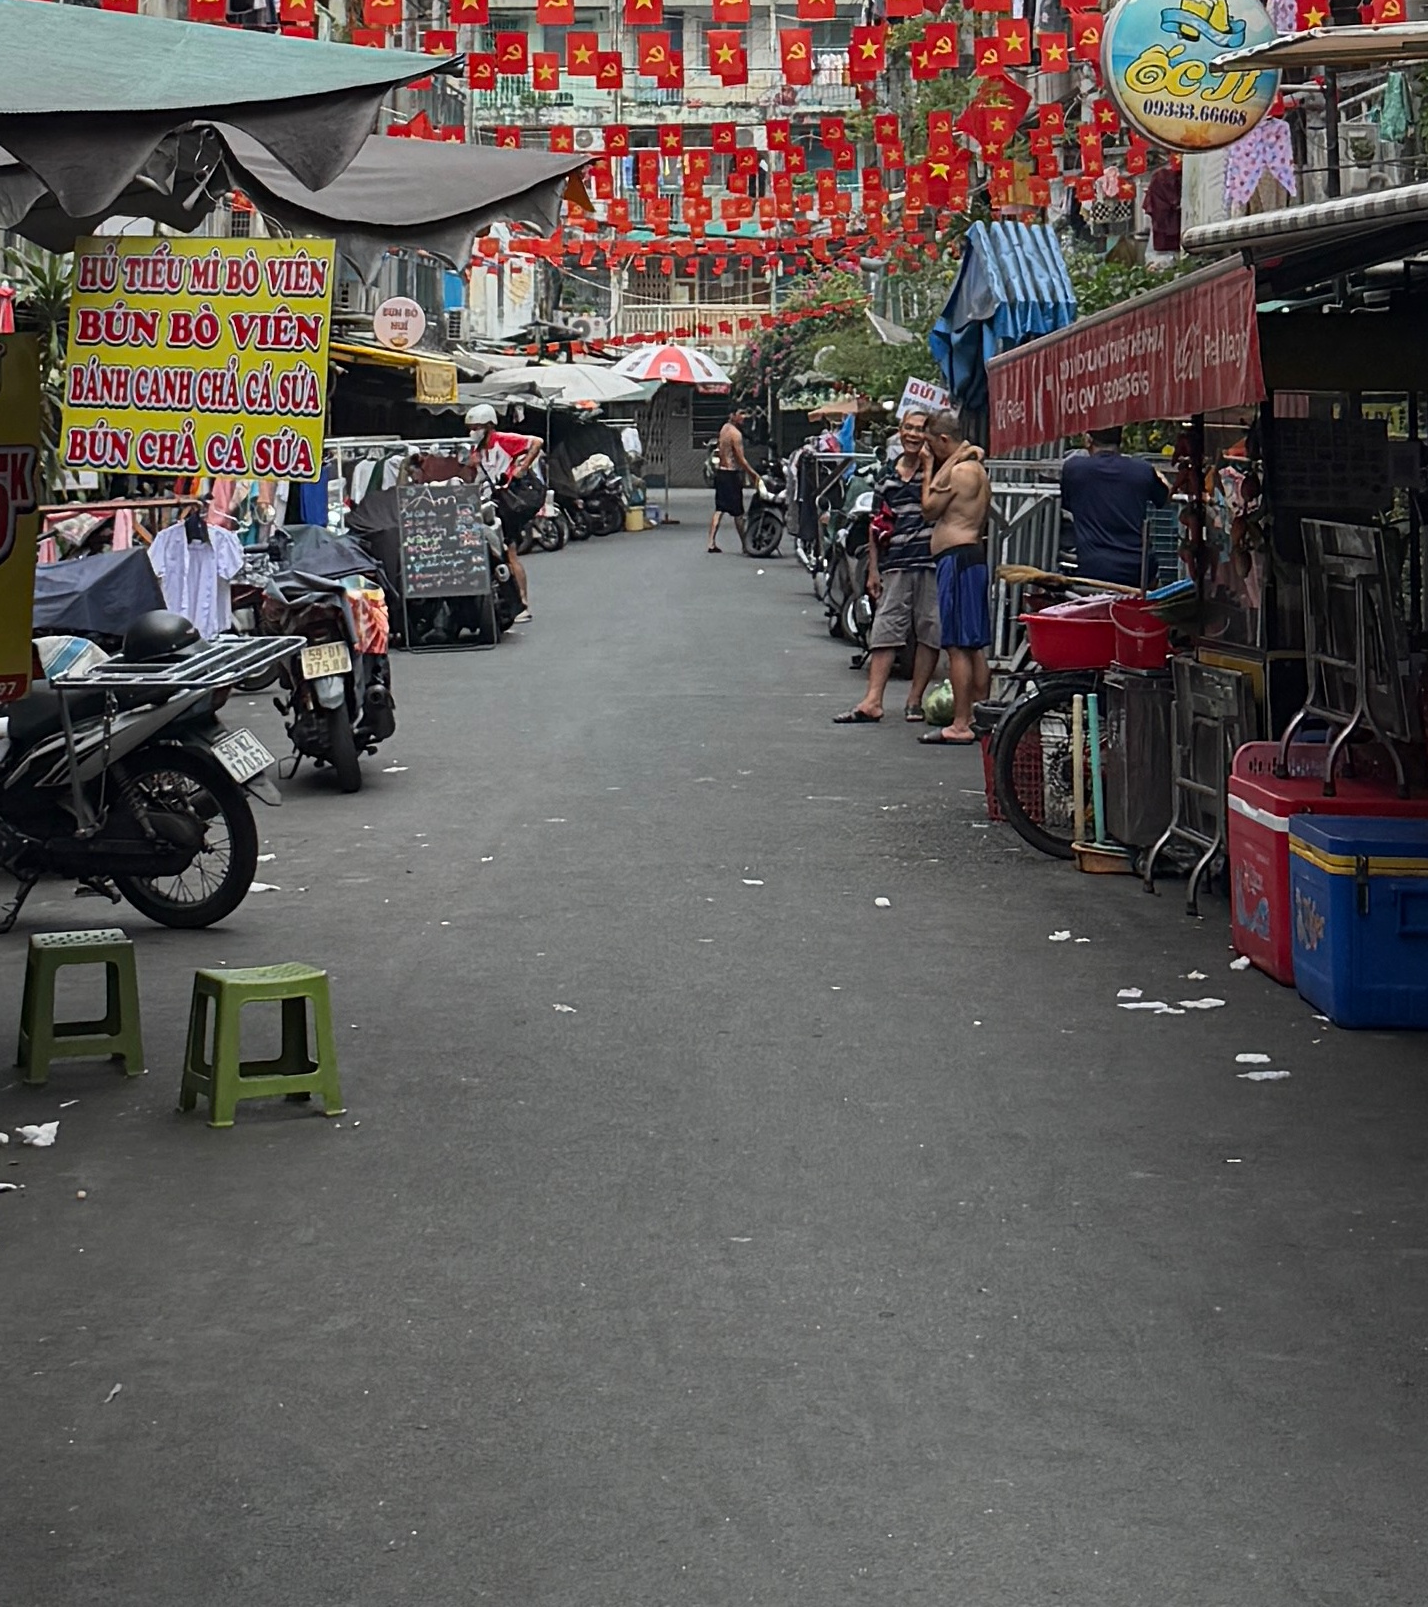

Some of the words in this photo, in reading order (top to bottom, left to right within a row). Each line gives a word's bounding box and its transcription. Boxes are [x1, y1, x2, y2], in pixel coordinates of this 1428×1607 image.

[1143, 99, 1248, 126] 09333.66668
[78, 243, 119, 291] HỦ
[123, 243, 185, 292] TIỂU
[188, 249, 222, 292] MÌ
[225, 247, 260, 292] BÒ
[266, 249, 328, 295] VIÊN
[76, 300, 160, 345] BÚN
[168, 303, 220, 347] BÒ
[229, 303, 323, 351] VIÊN
[70, 355, 130, 406] BÁNH
[134, 366, 194, 409] CANH
[195, 355, 241, 410] CHẢ
[244, 360, 274, 412] CÁ
[277, 361, 322, 415] SỨA
[66, 419, 132, 466] BÚN
[137, 420, 200, 469] CHẢ
[205, 425, 247, 473] CÁ
[253, 427, 314, 476] SỨA
